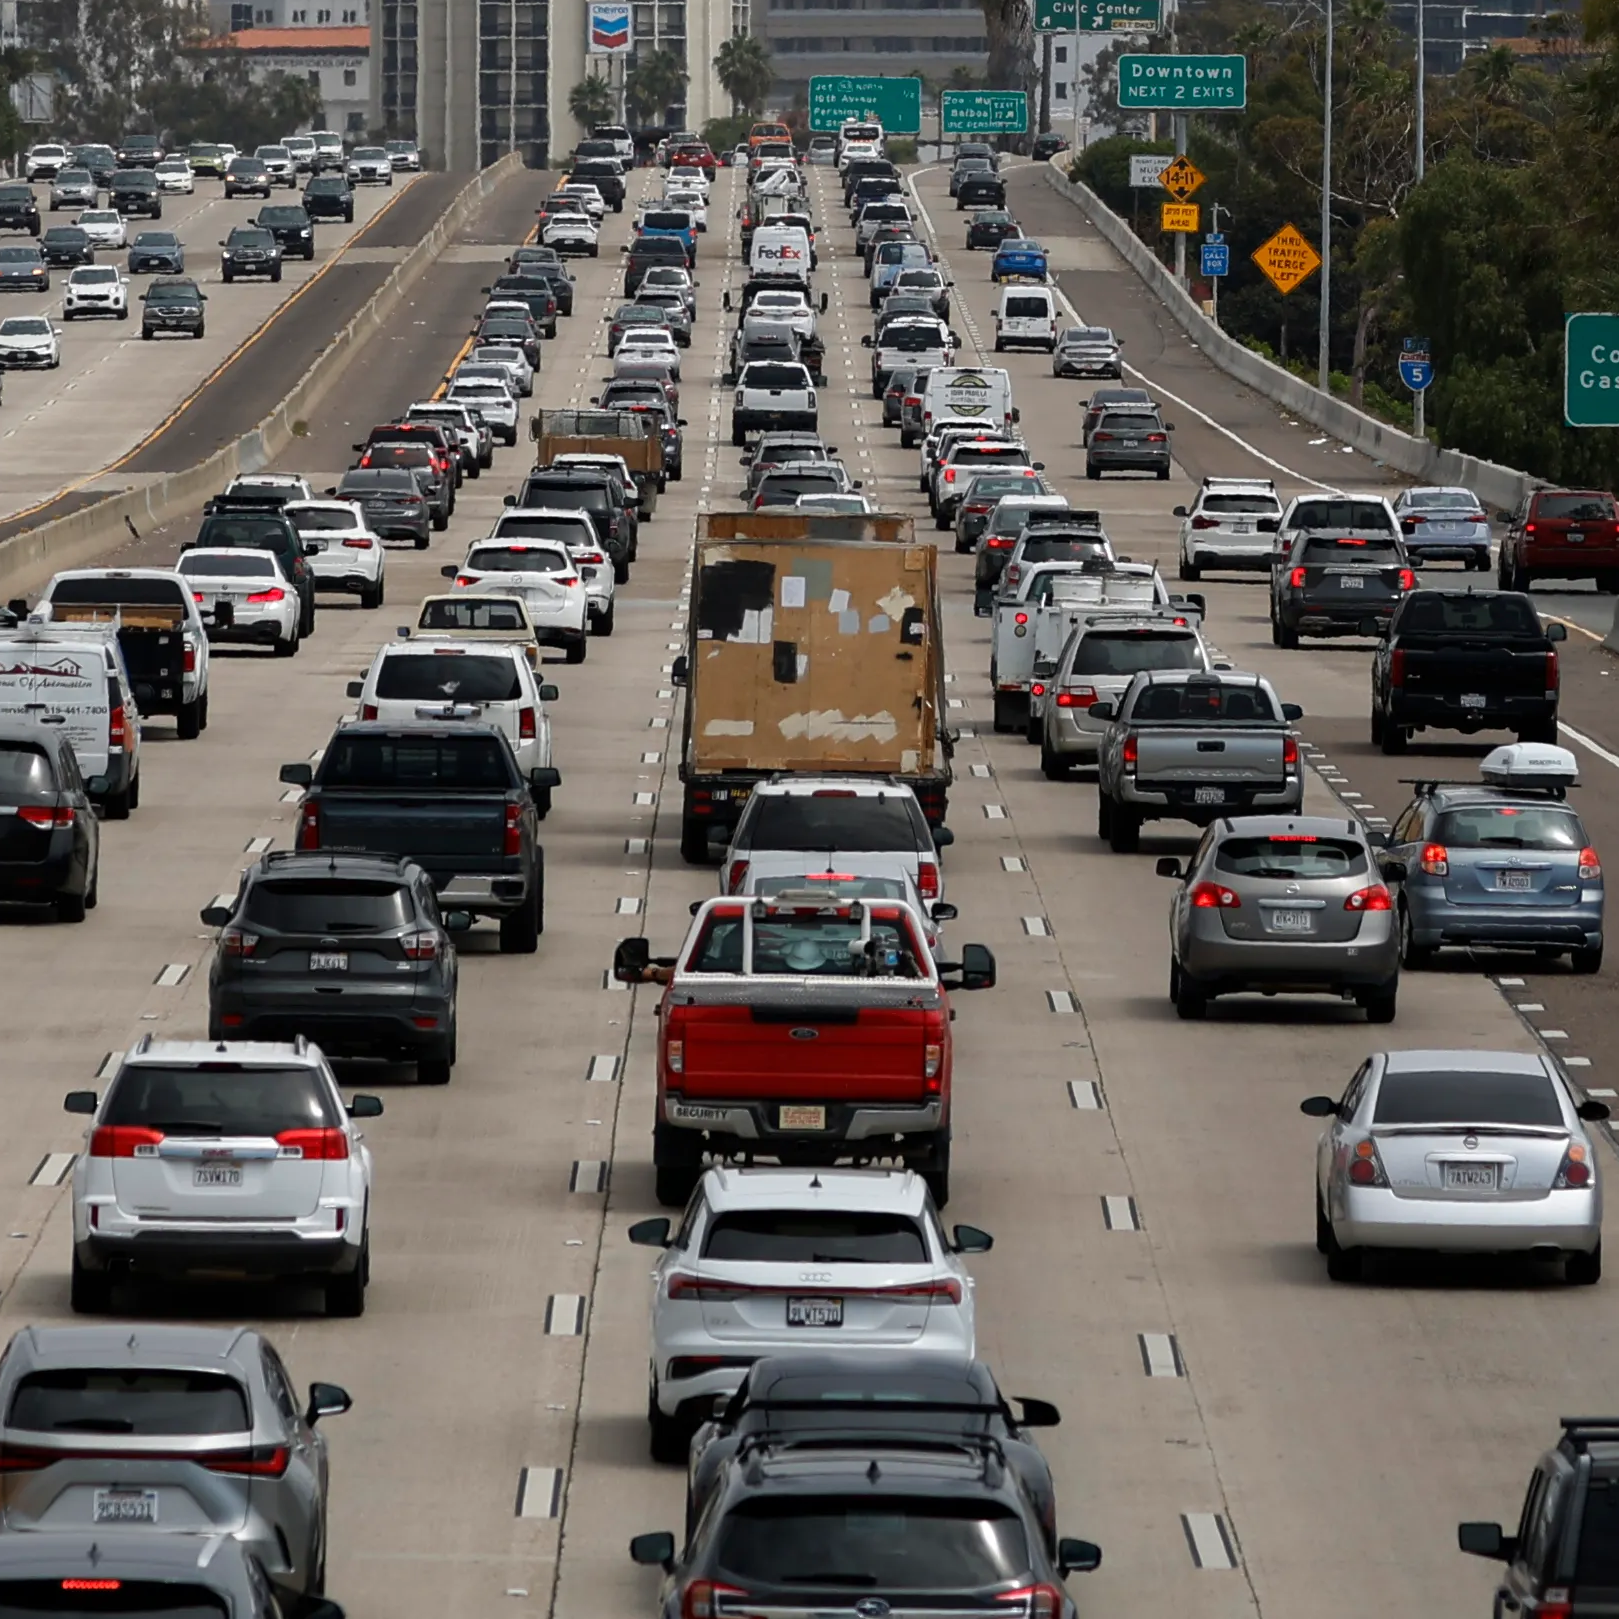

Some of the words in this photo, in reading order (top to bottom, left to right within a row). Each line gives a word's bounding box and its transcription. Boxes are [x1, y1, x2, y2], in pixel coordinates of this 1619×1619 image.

[1053, 2, 1088, 13] Civc
[1096, 3, 1142, 14] Center
[1132, 64, 1232, 79] Downtown
[1128, 86, 1166, 97] NEXT
[1175, 86, 1185, 99] 2
[1193, 86, 1234, 98] EXITS
[944, 96, 964, 105] Zoo
[951, 108, 988, 117] Balboa
[1277, 236, 1302, 247] THRU
[758, 245, 801, 260] FedEx
[1267, 247, 1308, 259] TRAFFIC
[1269, 259, 1306, 270] MERGE
[1412, 368, 1423, 382] 5
[677, 1107, 728, 1119] SECURITY
